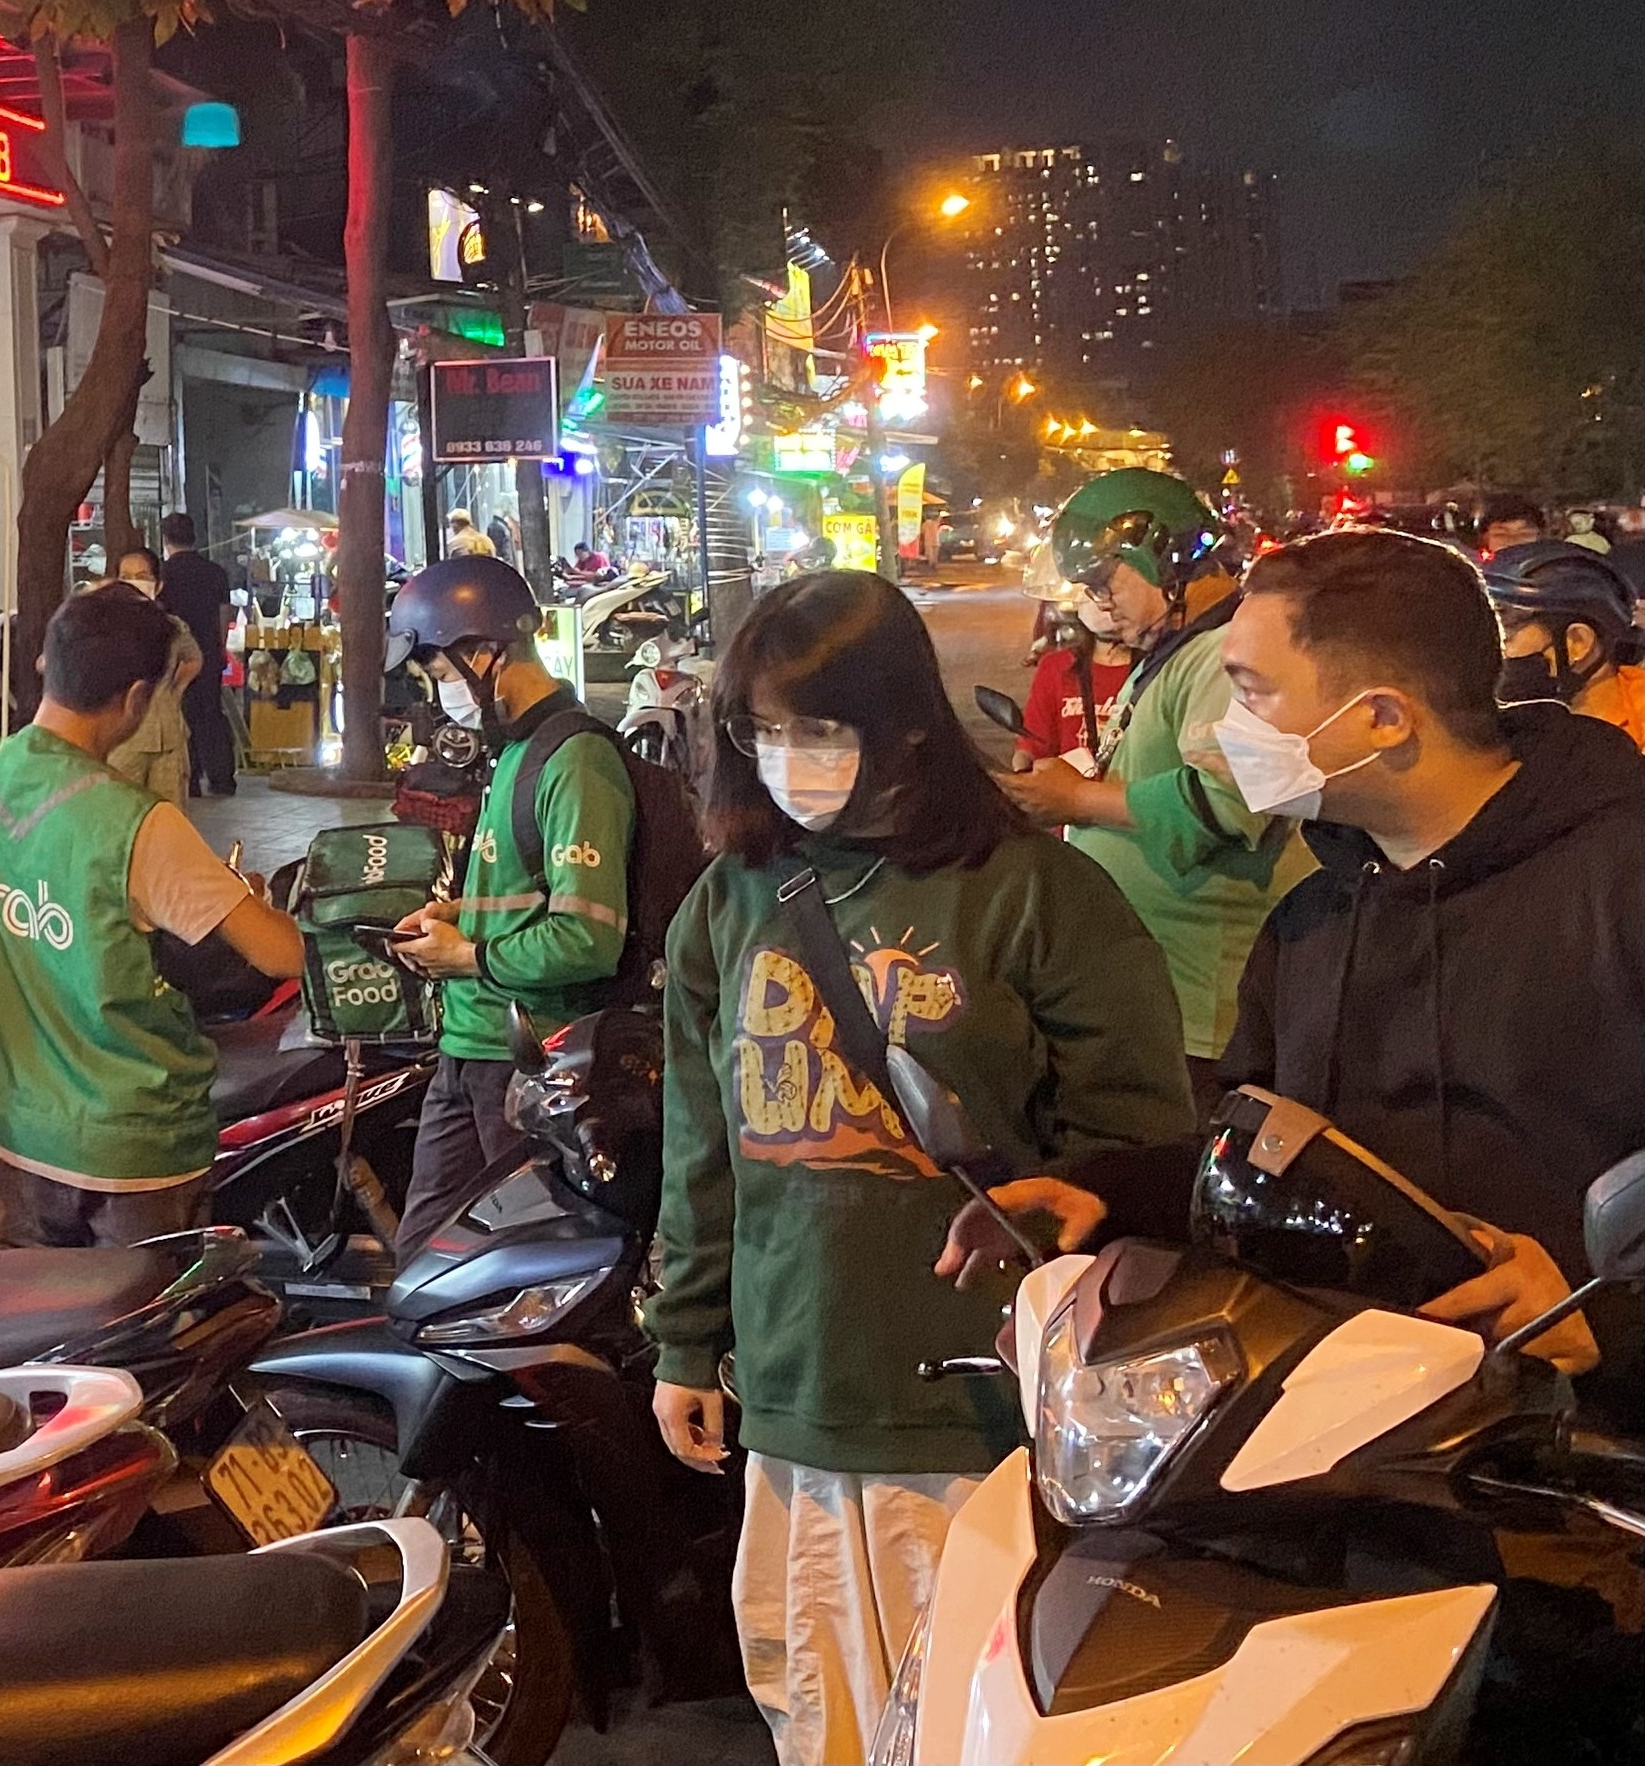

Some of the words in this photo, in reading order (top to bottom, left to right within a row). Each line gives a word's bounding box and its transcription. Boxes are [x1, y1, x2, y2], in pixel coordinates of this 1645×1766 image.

[624, 320, 702, 337] ENEOS
[625, 340, 675, 351] MOTOR
[679, 340, 702, 350] OIL
[650, 377, 672, 390] XE
[677, 377, 715, 391] NAM
[331, 977, 398, 1008] Food
[1086, 1575, 1162, 1609] HONDA
